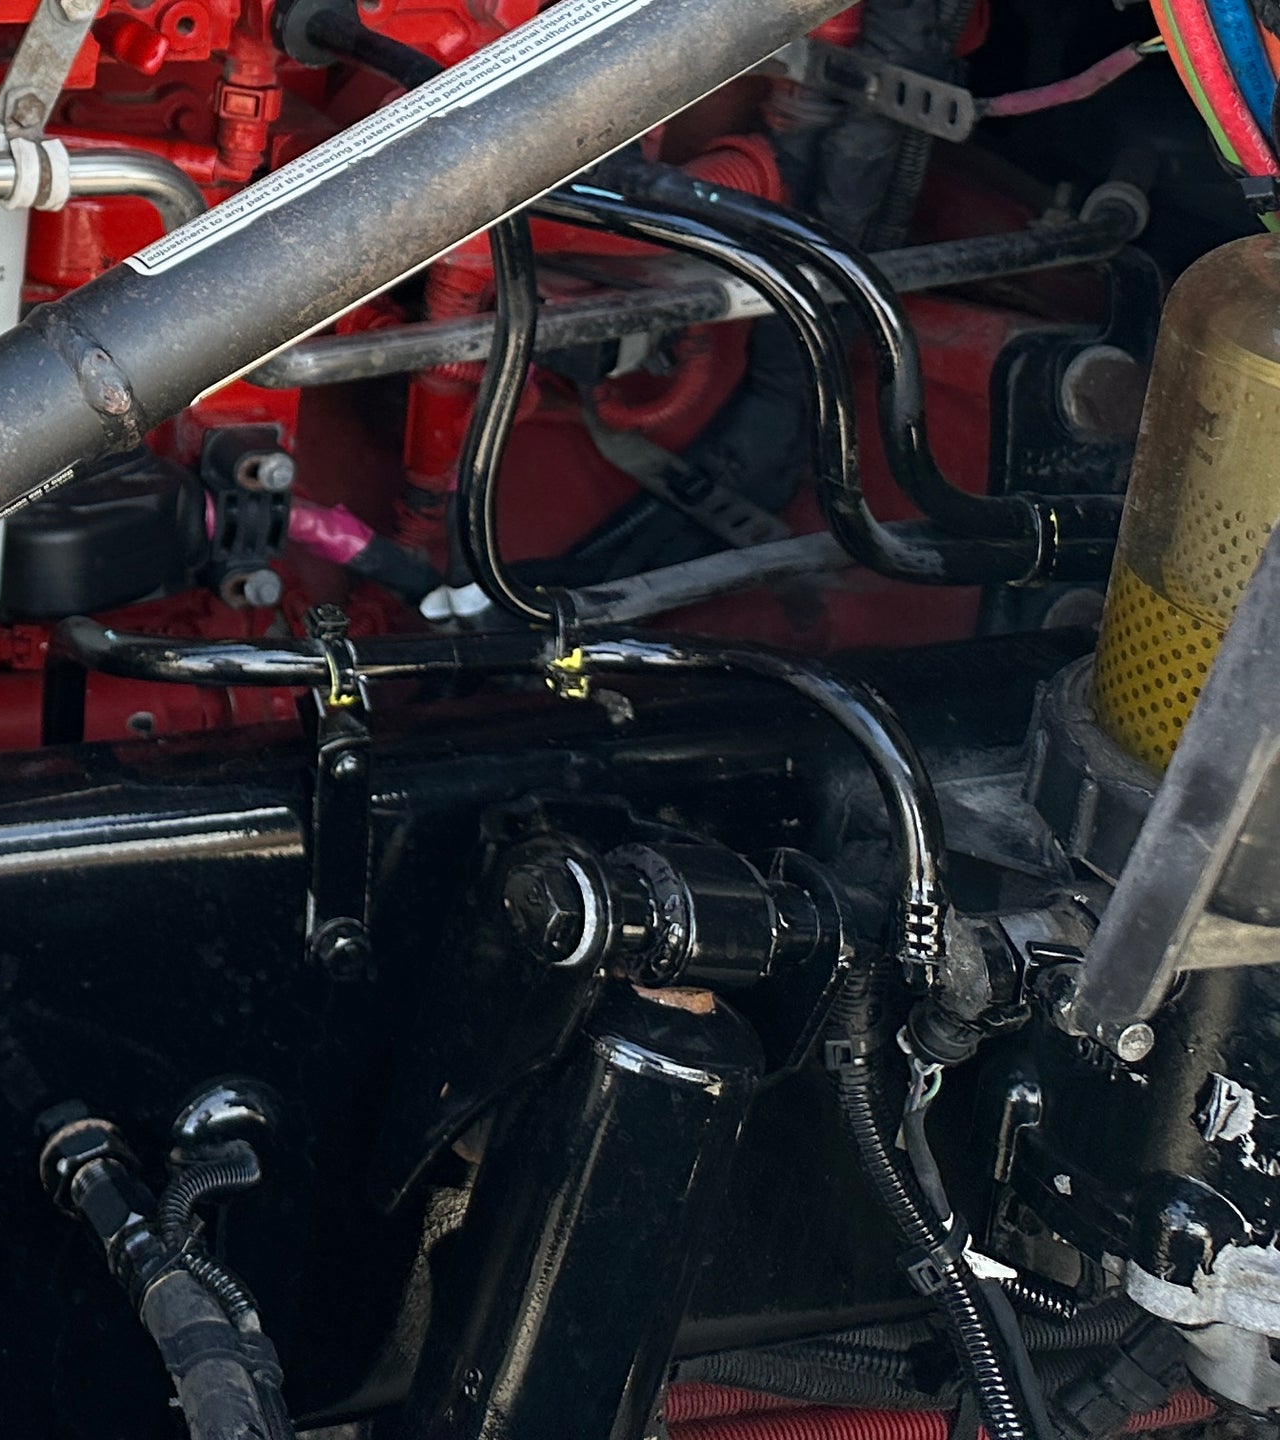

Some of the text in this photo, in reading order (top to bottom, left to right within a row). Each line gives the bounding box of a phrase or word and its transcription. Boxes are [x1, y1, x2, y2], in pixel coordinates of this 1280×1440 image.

[467, 55, 490, 72] and
[491, 27, 541, 60] personal
[539, 9, 572, 32] injury
[145, 222, 210, 264] adjustment
[223, 204, 245, 221] any
[245, 189, 271, 208] part
[286, 169, 304, 184] the
[305, 143, 353, 176] steering
[352, 120, 395, 149] system
[394, 103, 425, 125] must
[424, 94, 442, 108] be
[441, 60, 502, 99] performed
[500, 51, 517, 66] by
[517, 43, 534, 56] an
[532, 8, 593, 48] authorized
